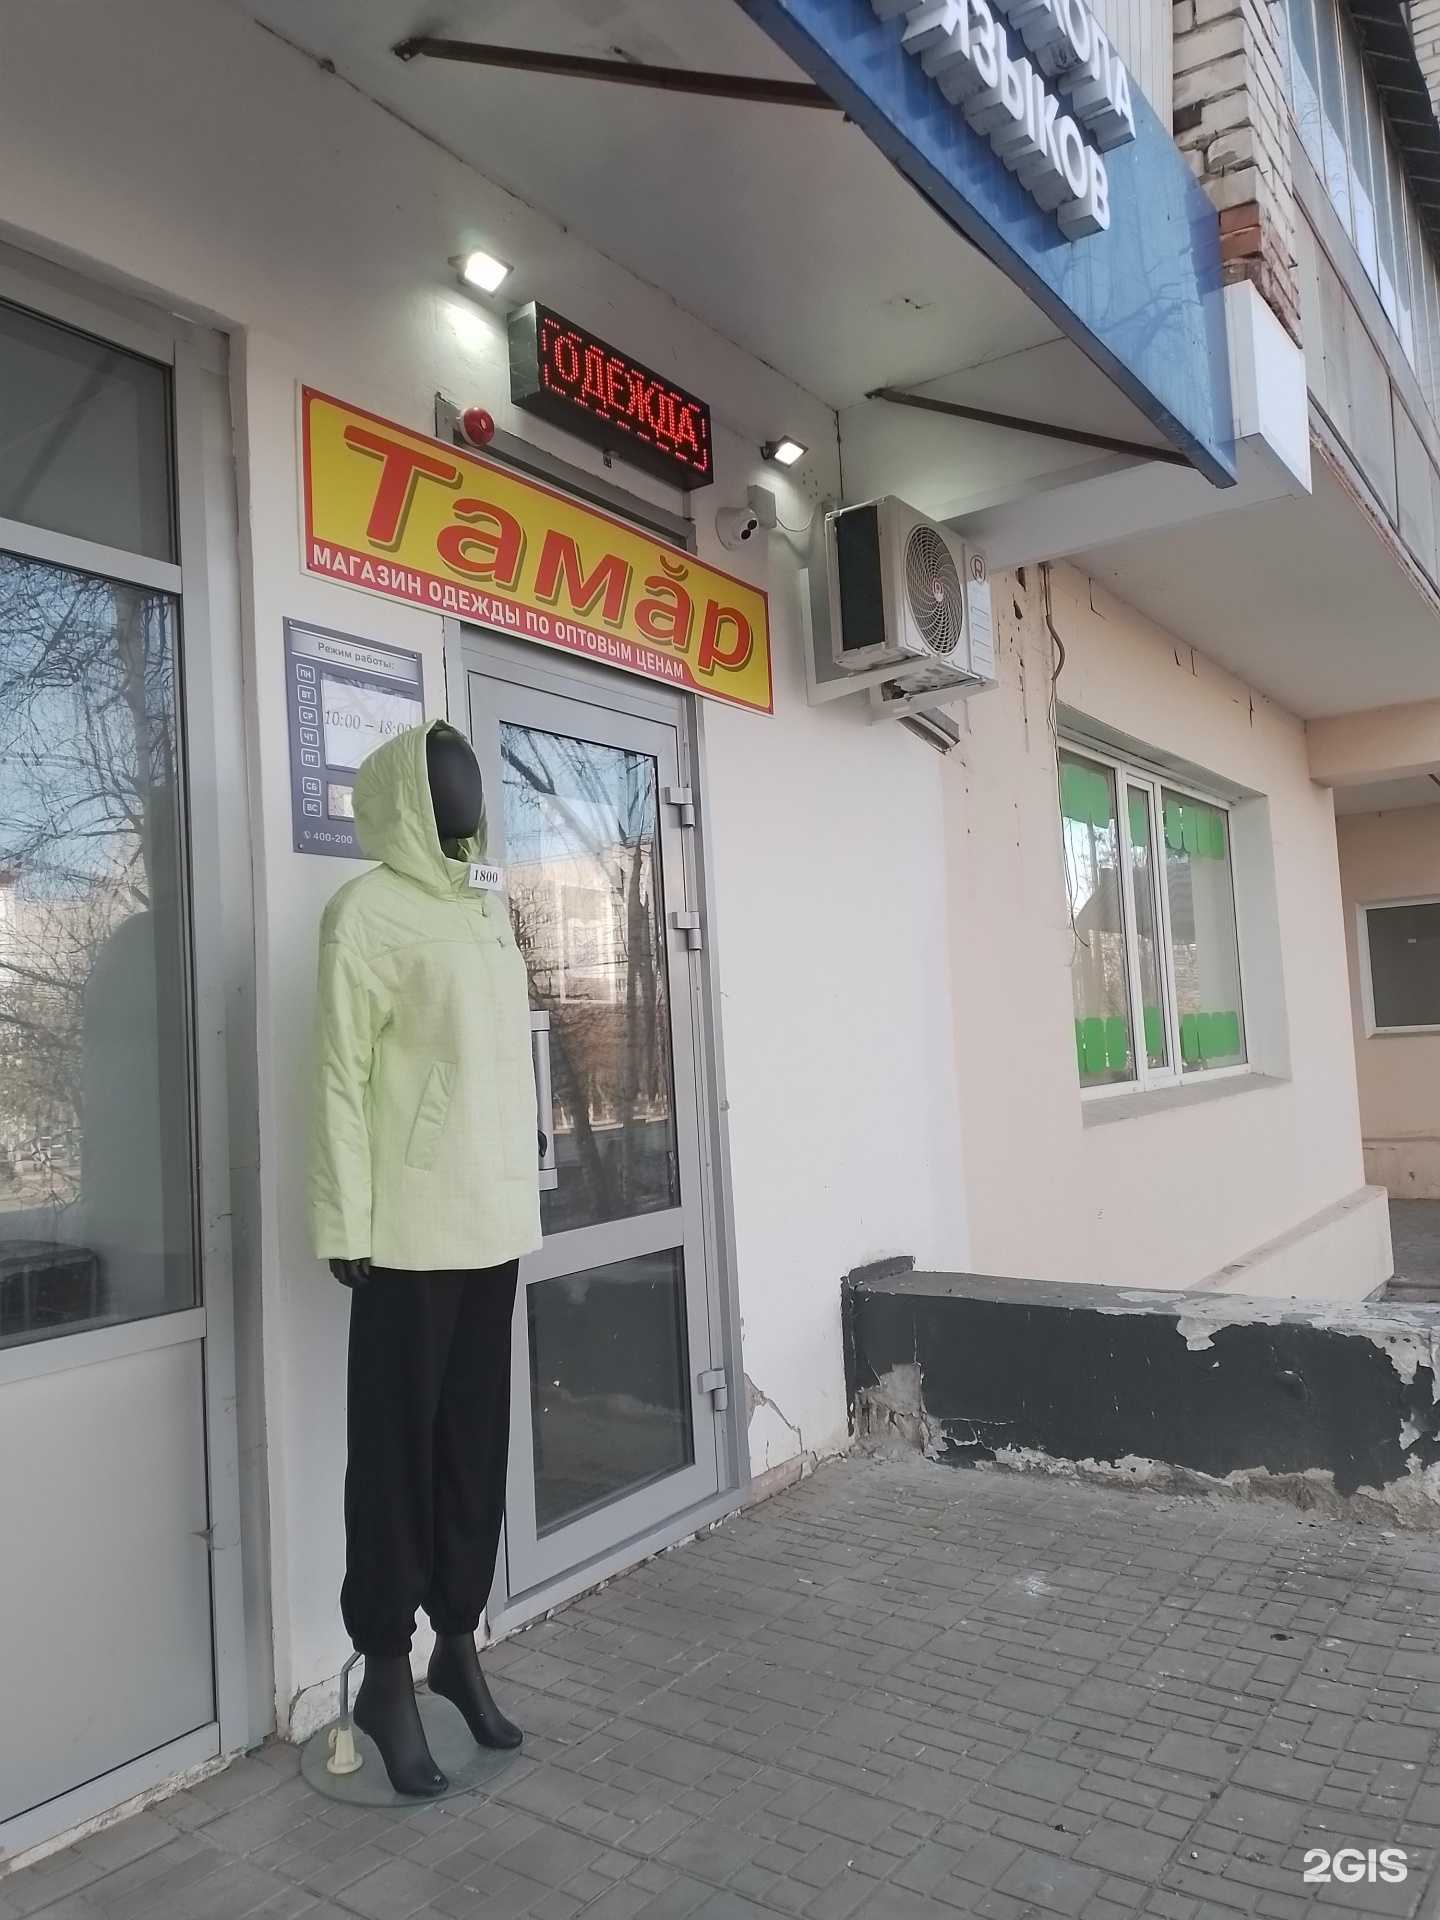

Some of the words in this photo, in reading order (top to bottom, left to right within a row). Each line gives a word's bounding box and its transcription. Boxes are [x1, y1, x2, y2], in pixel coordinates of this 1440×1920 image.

[554, 335, 699, 452] ОДЕЖДА
[313, 543, 421, 597] МАГАЗИН
[428, 581, 520, 627] ОДЕЖДЫ
[526, 611, 549, 635] ПО
[555, 621, 632, 662] ОПТОВЫМ
[636, 648, 684, 680] ЦЕНАМ
[317, 641, 352, 659] Режим
[354, 653, 395, 671] работы:
[300, 669, 312, 679] ПН
[302, 711, 313, 720] СР
[323, 711, 361, 730] 10:00
[303, 732, 314, 742] ЧТ
[305, 754, 316, 763] ПТ
[306, 782, 317, 791] СБ
[313, 831, 353, 845] 400-200
[474, 869, 499, 884] 1800
